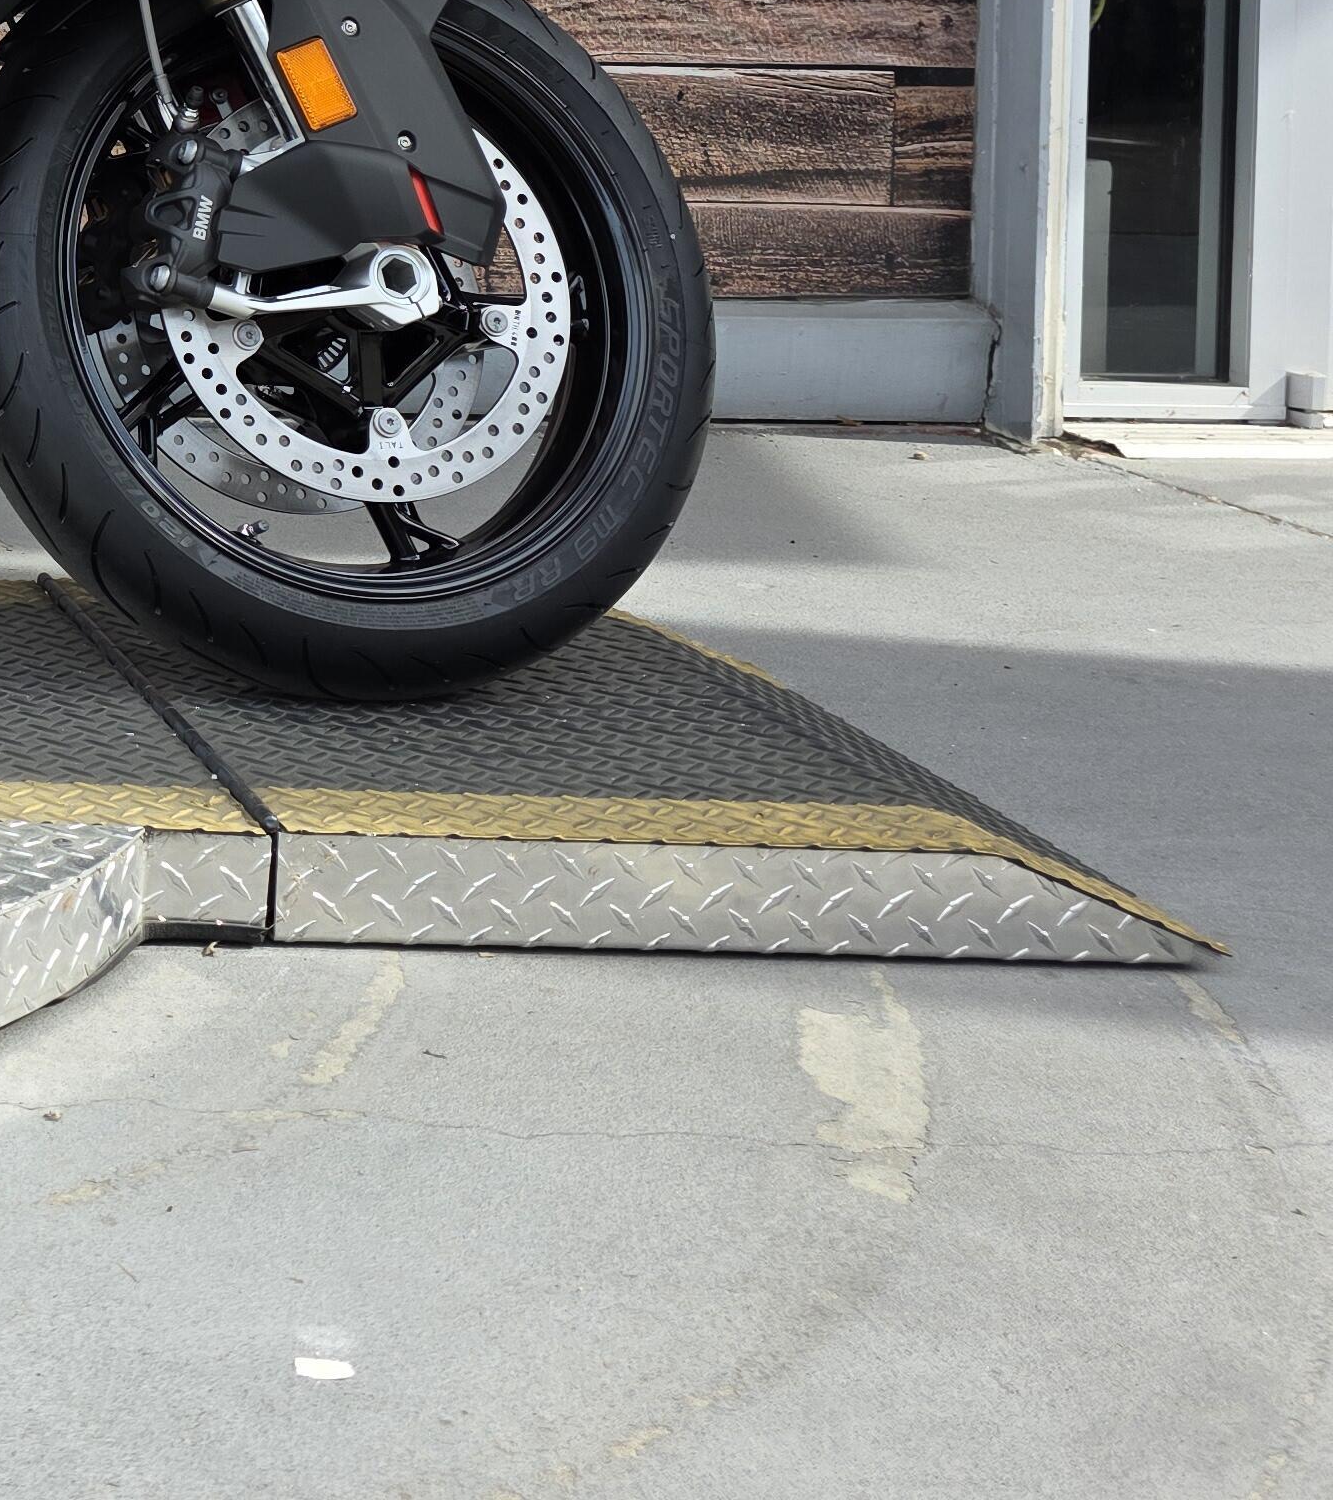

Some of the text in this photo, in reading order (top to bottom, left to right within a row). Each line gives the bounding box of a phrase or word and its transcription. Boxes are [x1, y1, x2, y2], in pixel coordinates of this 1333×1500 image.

[192, 194, 214, 241] BMW
[98, 445, 194, 550] 120/70
[506, 297, 682, 604] SPORTEC M9 RR
